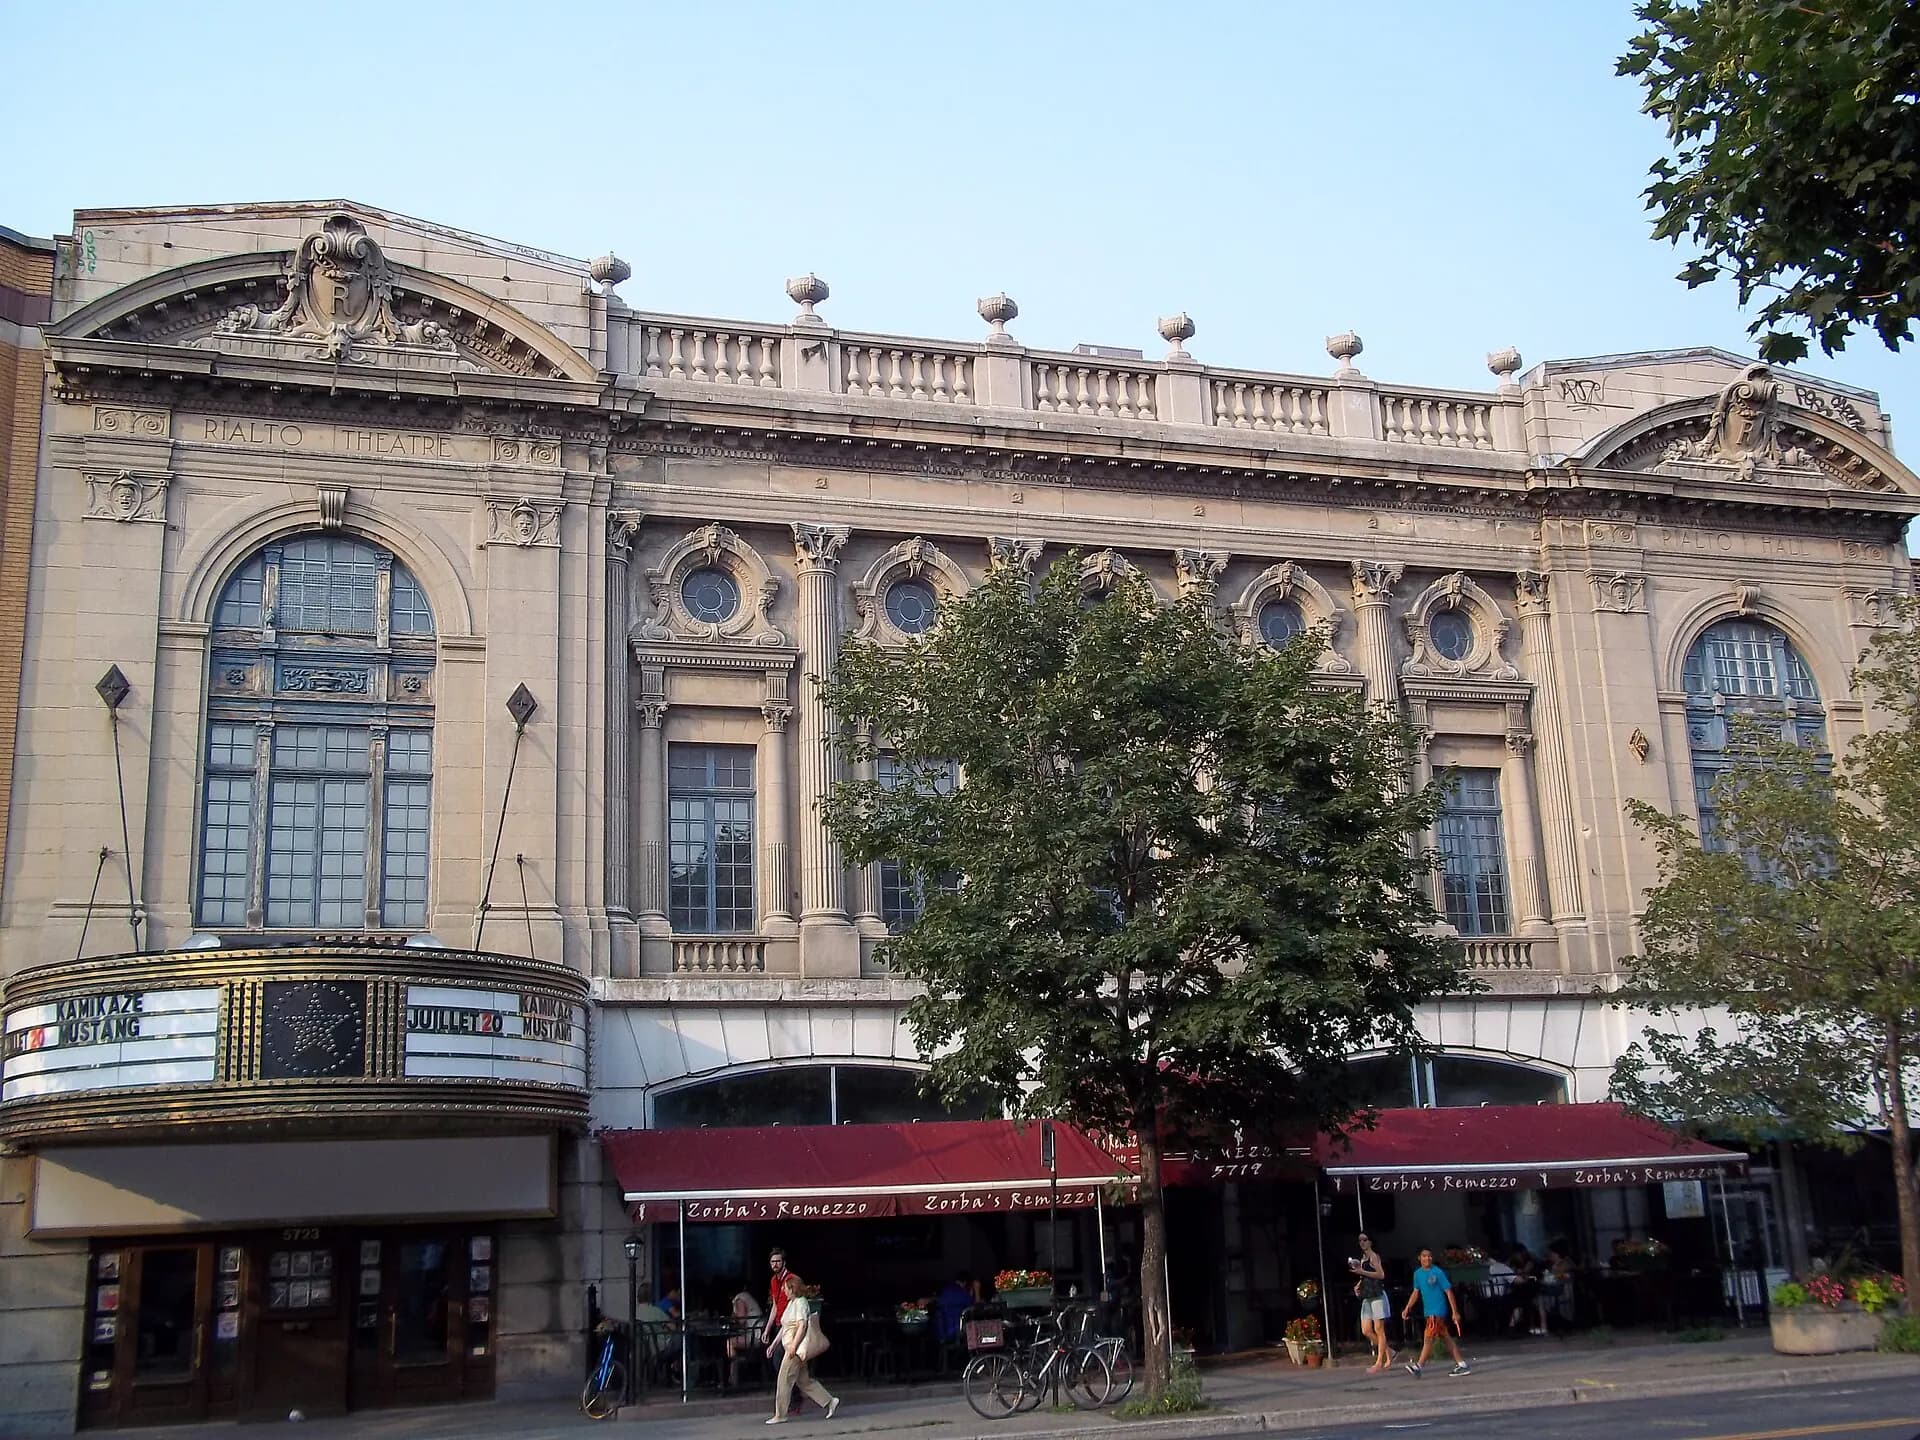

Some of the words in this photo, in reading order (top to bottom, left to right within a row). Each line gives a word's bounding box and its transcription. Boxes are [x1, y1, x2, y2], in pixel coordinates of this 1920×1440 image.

[331, 283, 351, 316] R
[204, 418, 303, 446] RIALTO
[342, 429, 452, 457] THEATRE
[1661, 529, 1732, 551] RIALTO
[1761, 535, 1809, 557] HALL
[58, 991, 143, 1020] KAMIKAZE
[60, 1017, 140, 1043] MUSTANG
[523, 1016, 572, 1041] MUSTANG
[1211, 1162, 1262, 1178] 5719
[1574, 1167, 1636, 1184] Zorba's
[1370, 1175, 1435, 1191] Zorba's
[1443, 1175, 1517, 1191] Remezzo
[687, 1200, 767, 1218] Zorba's
[776, 1201, 868, 1218] Remezzo
[925, 1191, 1000, 1210] Zorba's
[283, 1228, 320, 1241] 5723
